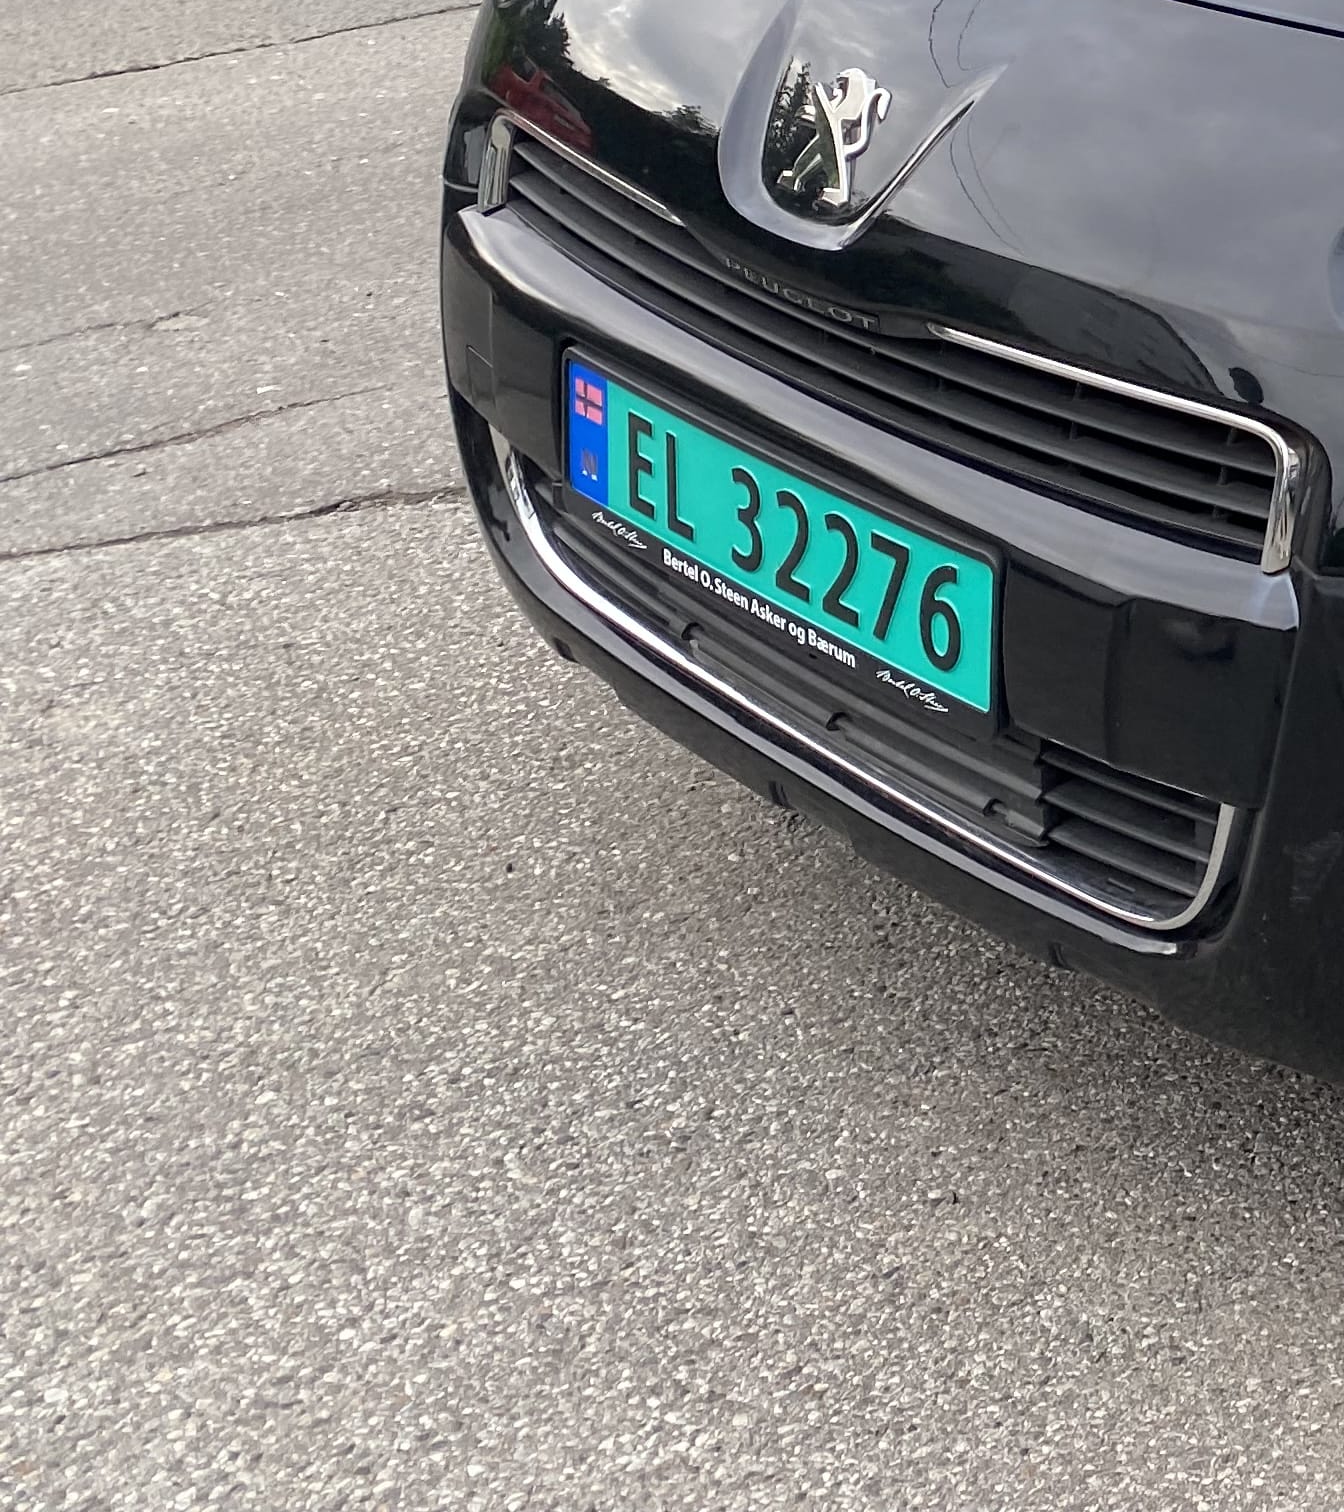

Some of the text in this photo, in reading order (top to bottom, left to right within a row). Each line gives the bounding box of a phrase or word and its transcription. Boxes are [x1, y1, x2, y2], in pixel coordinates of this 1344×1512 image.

[582, 447, 598, 481] N
[627, 410, 962, 673] EL 32276
[663, 548, 856, 669] Bertel O. Steen Asker og Bærum
